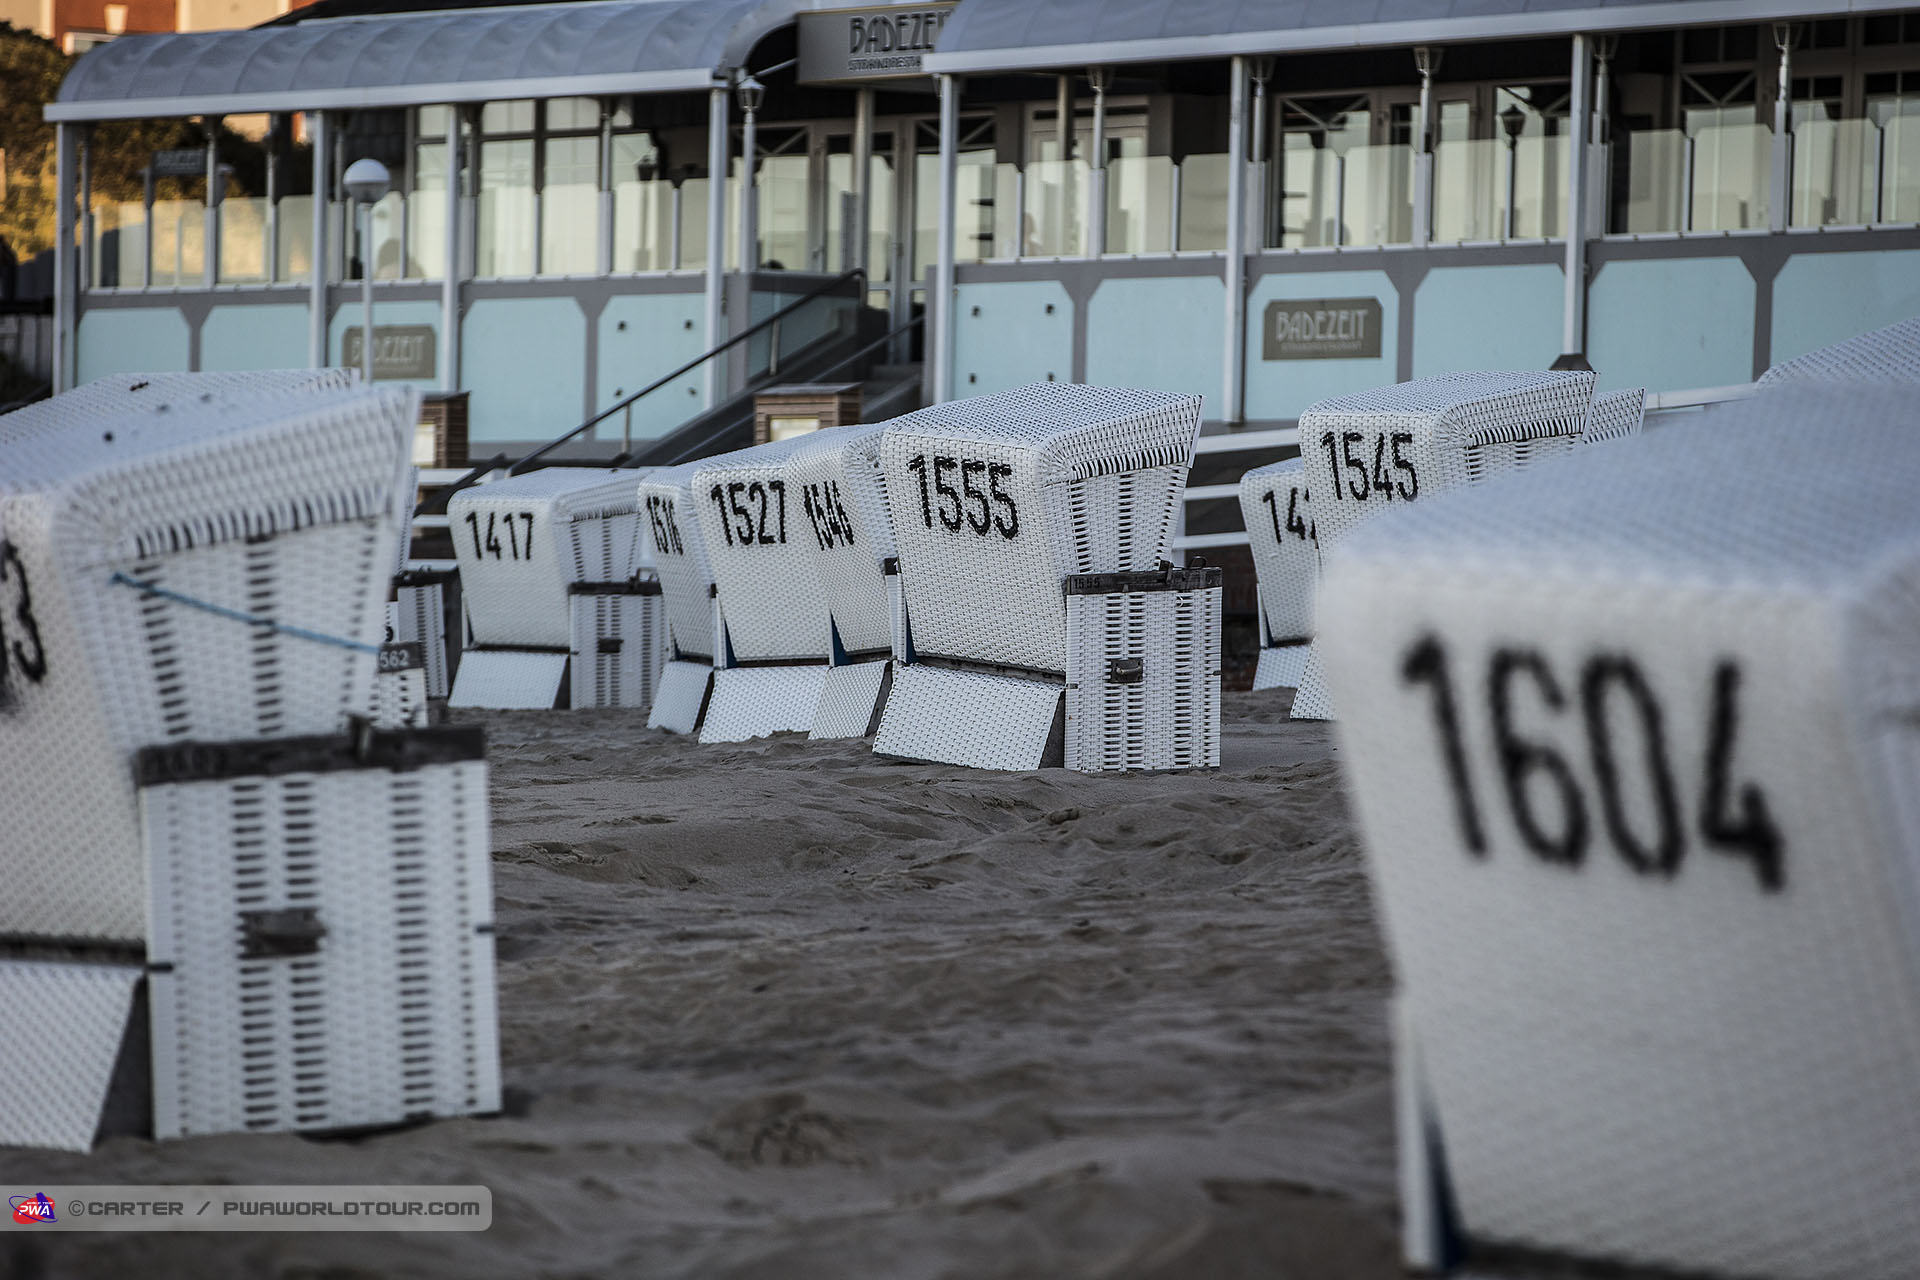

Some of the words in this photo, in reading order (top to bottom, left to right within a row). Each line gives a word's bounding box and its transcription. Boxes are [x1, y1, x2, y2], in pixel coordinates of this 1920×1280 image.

[849, 10, 951, 53] BADEZE
[352, 336, 424, 362] BDEZEIT
[1276, 310, 1368, 341] BADEZEIT
[1320, 431, 1418, 501] 1545
[711, 480, 786, 546] 1527
[907, 455, 1019, 540] 1555
[1263, 487, 1315, 543] 14
[466, 512, 533, 560] 1417
[1074, 577, 1100, 589] 1555
[1402, 634, 1786, 893] 1604
